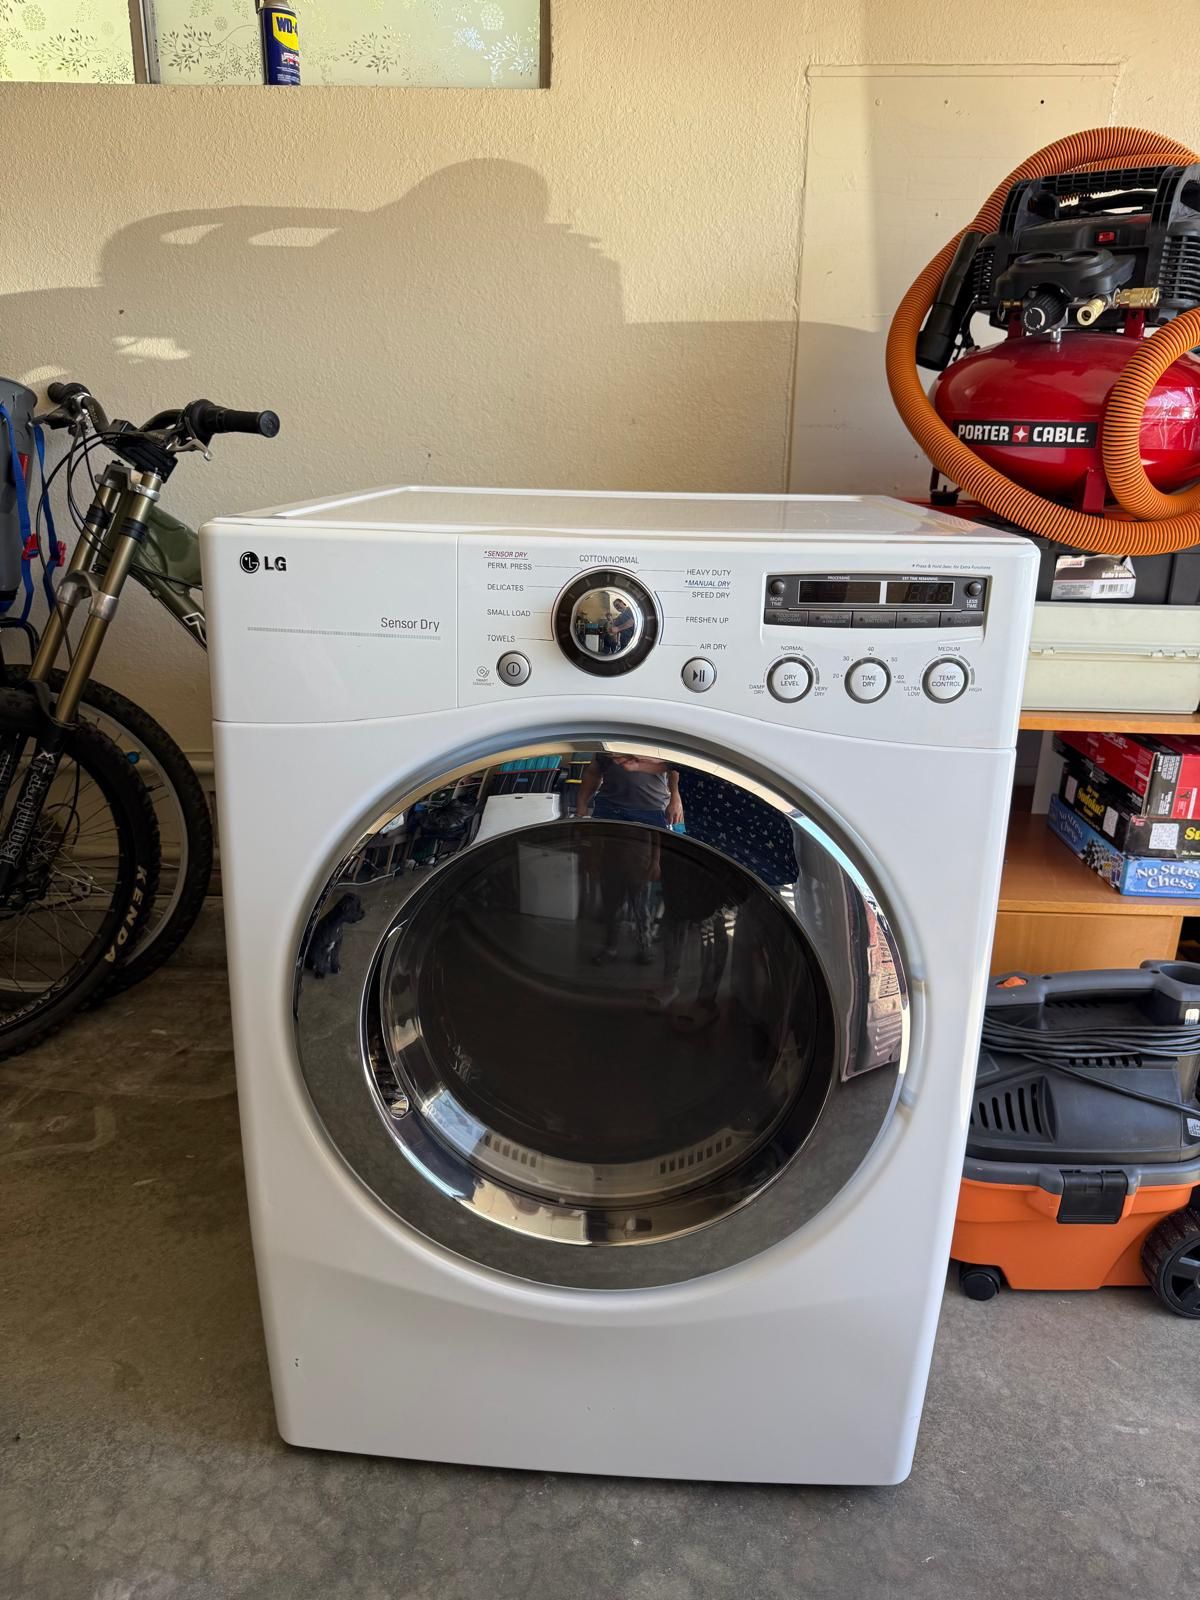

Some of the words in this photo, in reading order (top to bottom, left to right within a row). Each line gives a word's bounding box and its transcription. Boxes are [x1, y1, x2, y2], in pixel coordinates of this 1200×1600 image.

[957, 423, 1010, 441] PORTER
[1032, 426, 1086, 443] CABLE
[264, 556, 287, 572] LG
[579, 554, 639, 564] COTTON/NORMAL
[510, 562, 532, 571] PRESS
[487, 583, 524, 592] DELICATES
[487, 608, 510, 616] SMALL
[511, 609, 531, 617] LOAD
[380, 617, 418, 630] Sensor
[420, 619, 440, 632] Dry
[685, 616, 718, 624] FRESHEN
[487, 634, 516, 642] TOWELS
[1136, 863, 1158, 879] No
[1147, 874, 1196, 891] Chess
[104, 864, 148, 964] KENDA
